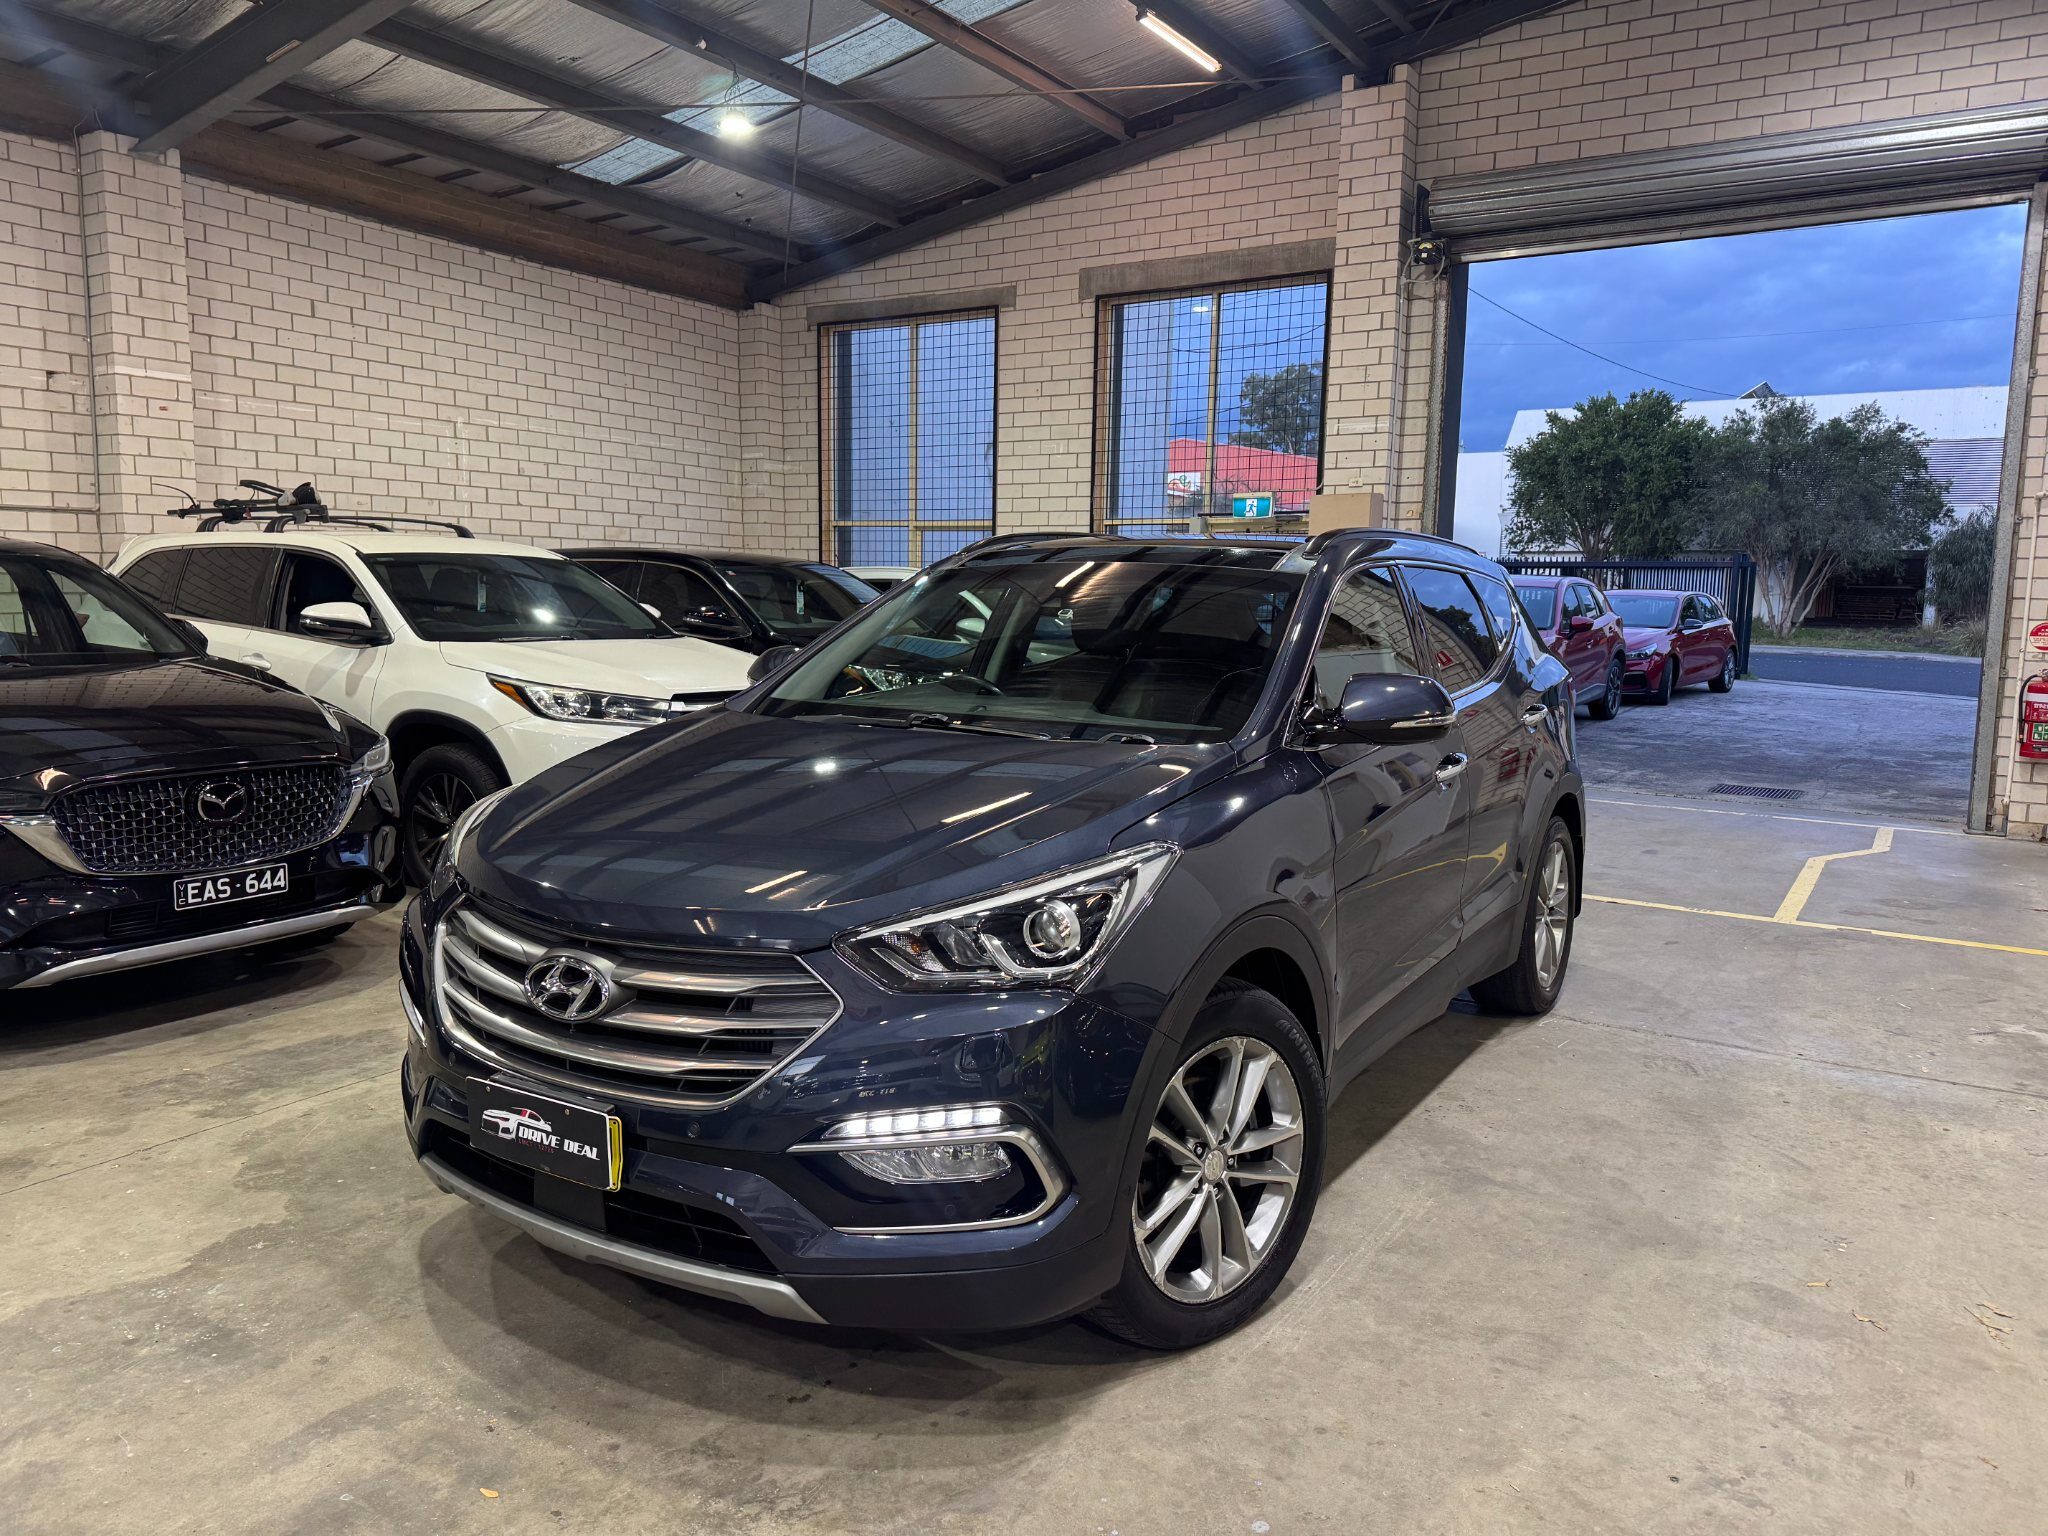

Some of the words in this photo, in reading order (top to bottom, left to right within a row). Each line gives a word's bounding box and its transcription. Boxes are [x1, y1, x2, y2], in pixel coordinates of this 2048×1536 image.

[187, 878, 231, 904] EAS
[245, 868, 286, 893] 644
[518, 1125, 560, 1149] DRIVE
[563, 1139, 601, 1161] DEAL
